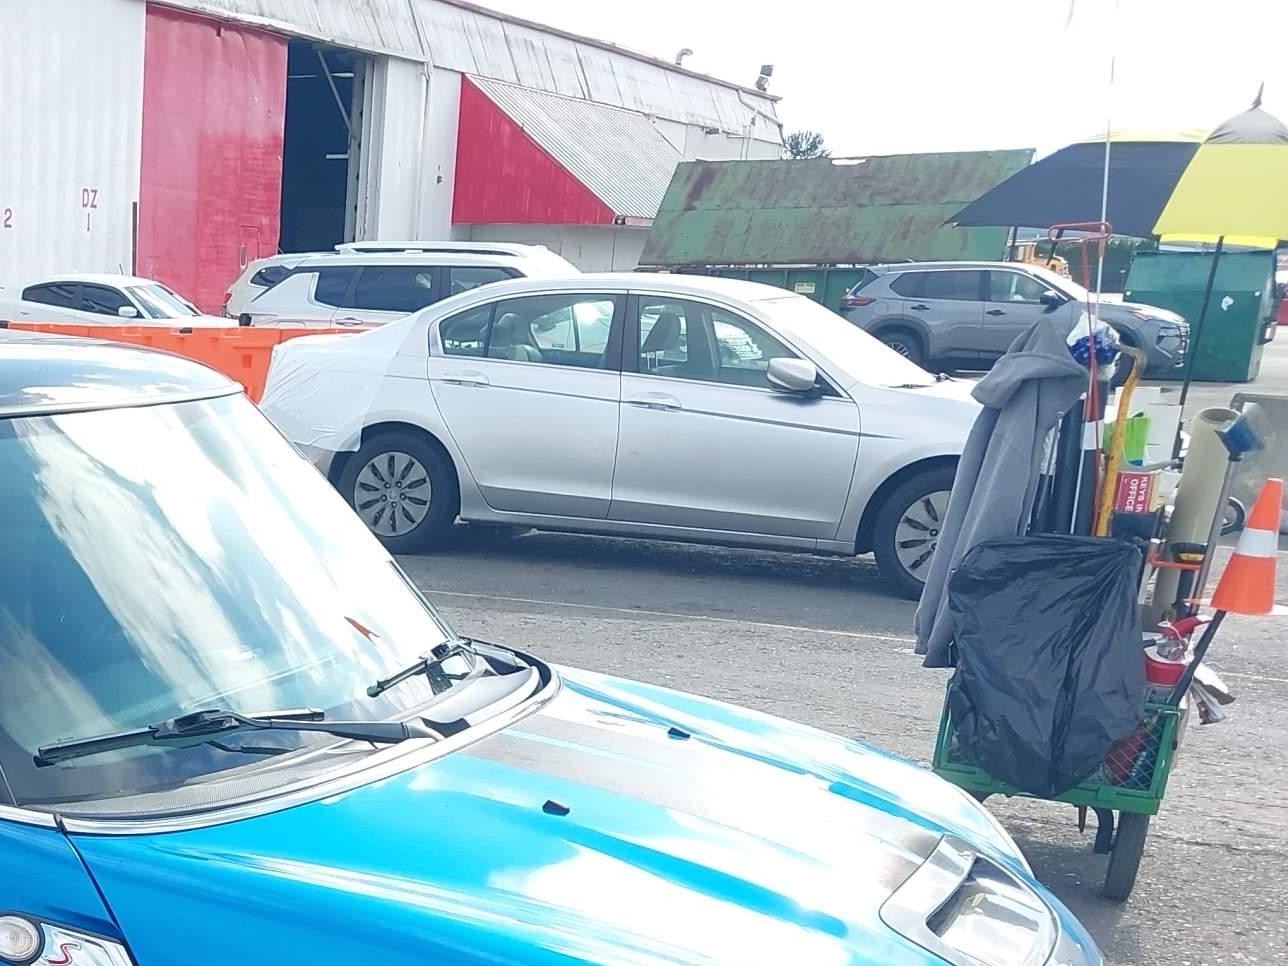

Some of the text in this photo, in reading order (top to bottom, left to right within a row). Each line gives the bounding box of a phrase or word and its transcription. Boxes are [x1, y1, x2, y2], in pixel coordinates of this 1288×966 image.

[3, 207, 14, 229] 2
[1124, 478, 1139, 512] OFFICE
[1137, 476, 1148, 501] KEYS
[46, 942, 82, 966] S
